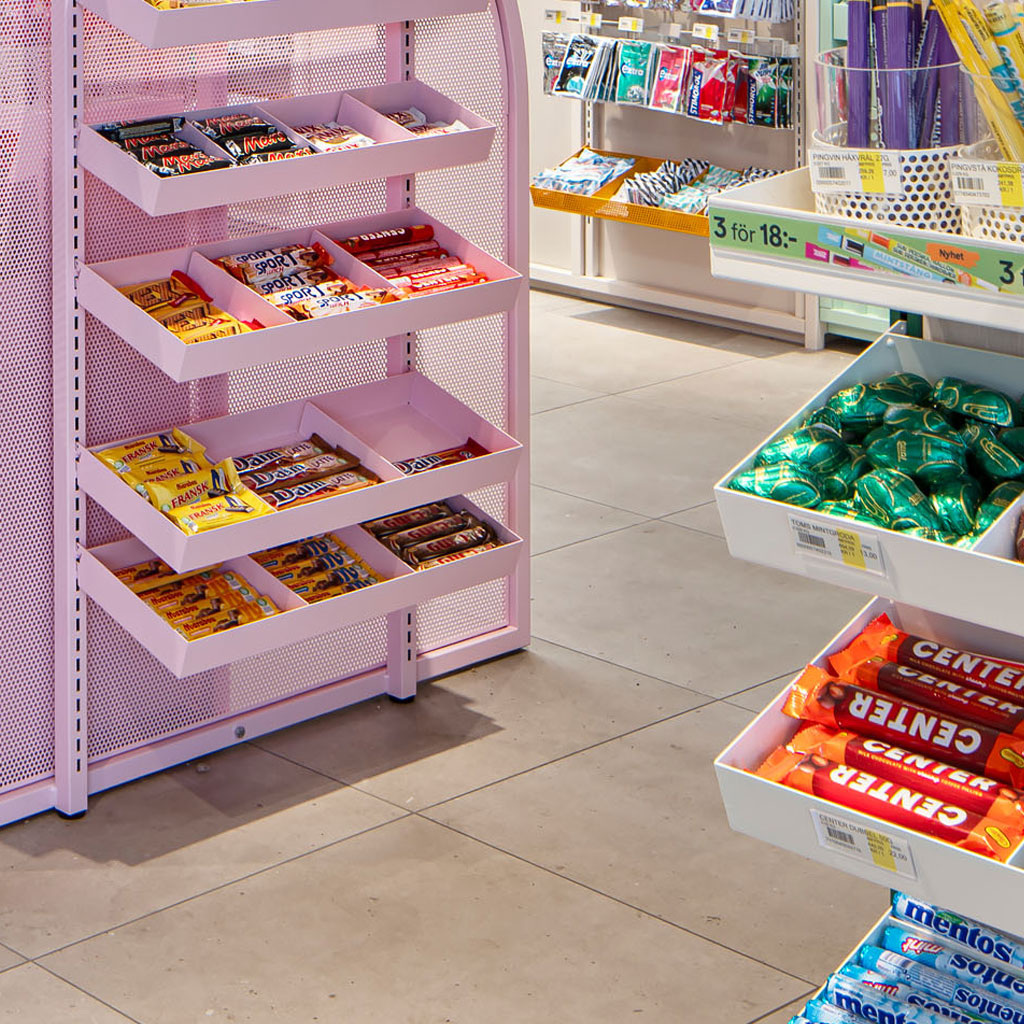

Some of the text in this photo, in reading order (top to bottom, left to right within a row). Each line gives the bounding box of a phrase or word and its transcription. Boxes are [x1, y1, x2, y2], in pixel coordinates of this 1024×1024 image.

[689, 72, 702, 116] STIMOROL
[219, 117, 262, 134] Mars
[142, 141, 189, 160] Mars
[243, 131, 287, 154] Mars
[361, 227, 406, 241] CENTER
[713, 216, 797, 248] 3 för 18:-
[236, 249, 277, 263] SPORT
[255, 253, 297, 275] SPORT
[939, 249, 964, 263] Nyhet
[999, 260, 1014, 284] 3
[261, 274, 306, 294] SPORT
[280, 285, 325, 305] SPORT
[316, 292, 364, 308] SPORT
[122, 441, 157, 463] FRANSK
[234, 449, 282, 473] Daim
[255, 462, 306, 490] Daim
[396, 459, 442, 476] Daim
[172, 483, 210, 509] FRANSK
[276, 479, 326, 507] Daim
[189, 503, 225, 521] FRANSK
[848, 692, 982, 755] CENTER
[863, 739, 998, 792] CENTER
[871, 754, 902, 770] CHOCOLATE
[829, 764, 968, 826] CENTER
[905, 901, 1014, 964] mentos
[901, 937, 944, 955] mint
